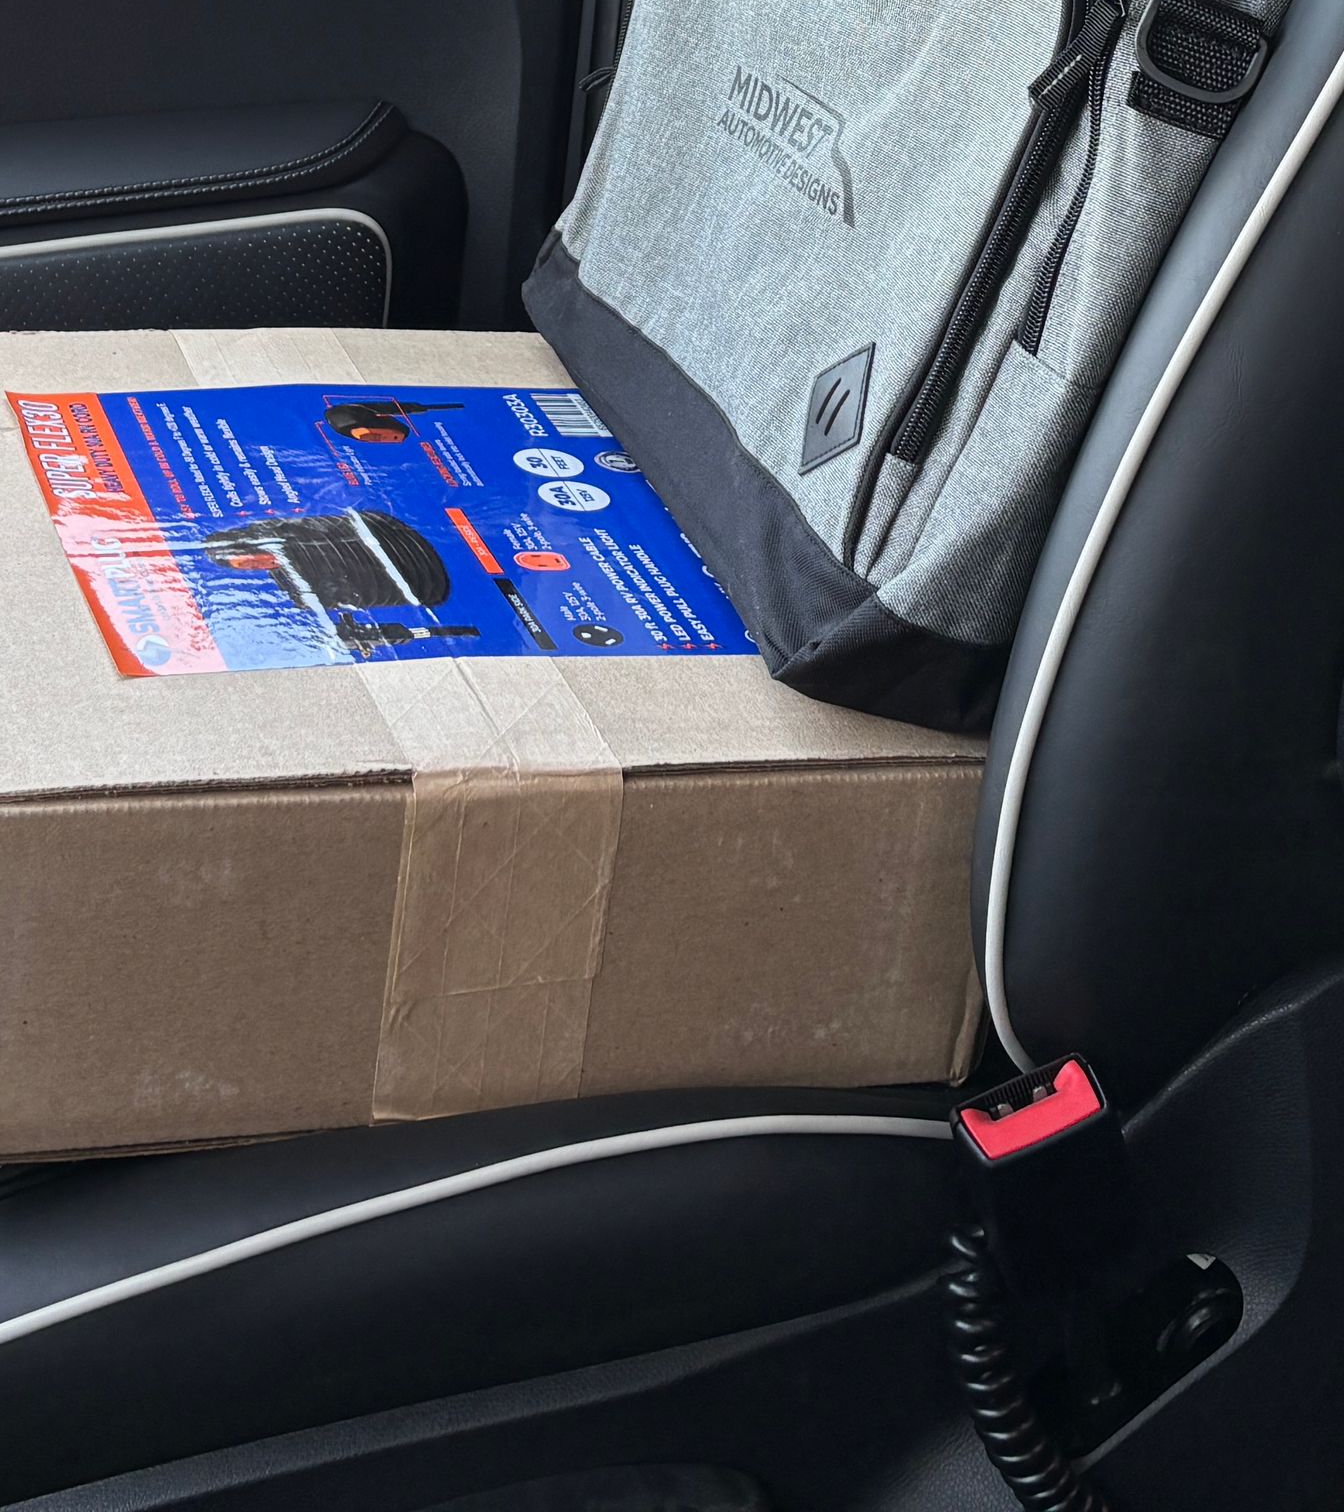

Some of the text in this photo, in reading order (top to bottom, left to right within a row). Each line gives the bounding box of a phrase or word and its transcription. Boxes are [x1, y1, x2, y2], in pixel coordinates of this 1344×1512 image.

[728, 64, 834, 160] MIDWEST
[716, 108, 841, 216] AUTOMOTIVE DESIGNS
[67, 402, 94, 423] CORD
[183, 406, 200, 427] weather
[503, 394, 547, 436] R30303A
[194, 428, 209, 443] warm
[216, 419, 234, 438] flexible
[17, 399, 97, 499] SUPER FLEX30
[87, 448, 114, 467] DUTY
[204, 451, 220, 464] cold
[229, 440, 247, 462] remains
[526, 457, 548, 468] 30
[551, 456, 569, 469] FEET
[96, 469, 125, 493] HEAVY
[216, 472, 235, 490] tightly
[243, 468, 260, 485] easily
[259, 446, 300, 503] Angled Head Design
[549, 486, 576, 505] 30A
[577, 489, 595, 502] 125V
[503, 529, 523, 549] Female
[579, 537, 605, 561] CABLE
[629, 545, 661, 574] HANDLE
[594, 529, 690, 640] LED POWER INDICATOR LIGHT
[598, 562, 628, 590] POWER
[654, 576, 678, 596] PLUG
[508, 594, 523, 605] SIDE
[620, 592, 638, 603] RV
[517, 607, 533, 621] PARK
[560, 606, 576, 620] Male
[631, 605, 651, 620] 30A
[673, 598, 696, 617] PULL
[651, 630, 667, 641] 30
[688, 619, 714, 640] EASY
